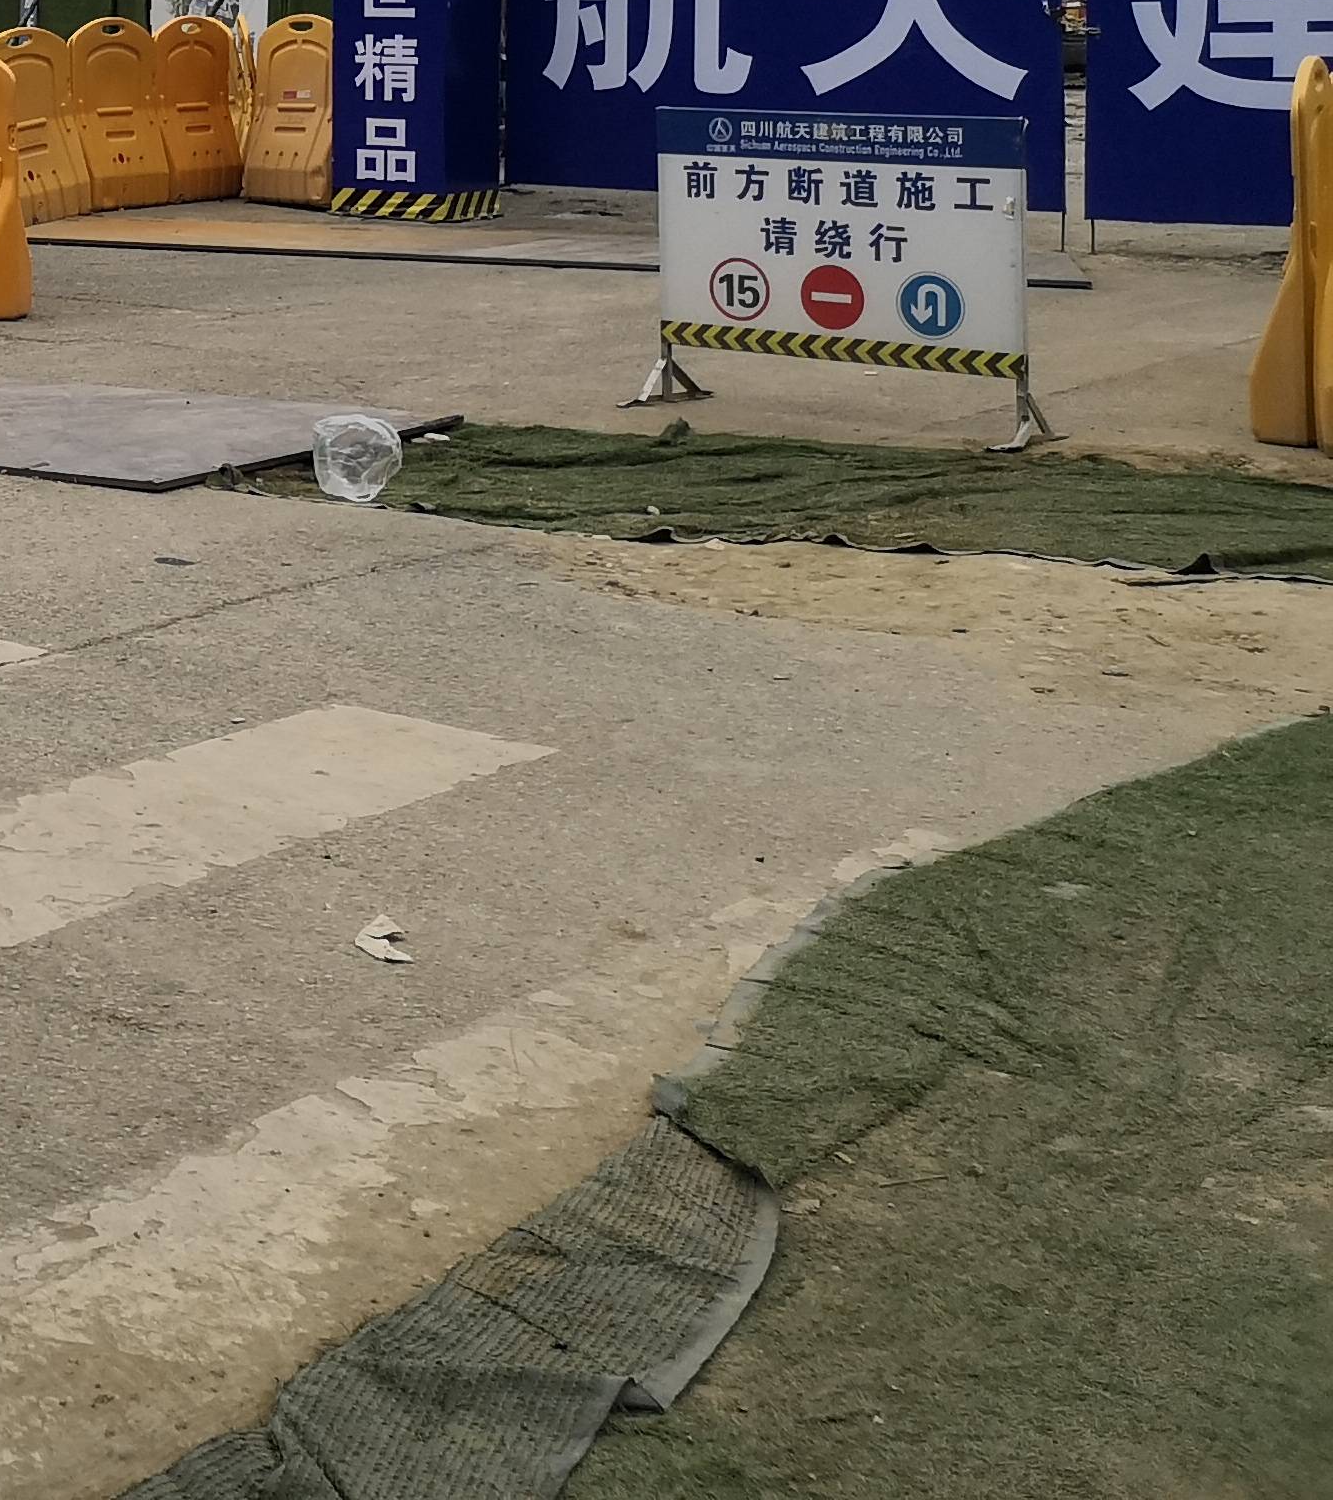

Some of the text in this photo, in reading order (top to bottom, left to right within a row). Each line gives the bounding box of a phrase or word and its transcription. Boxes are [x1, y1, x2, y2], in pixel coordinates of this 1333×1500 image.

[740, 121, 963, 145] 四川航天建筑工程有限公司
[819, 143, 872, 155] Construction
[683, 161, 994, 211] 前方断道施工
[760, 217, 908, 263] 请绕行
[718, 273, 761, 309] 15
